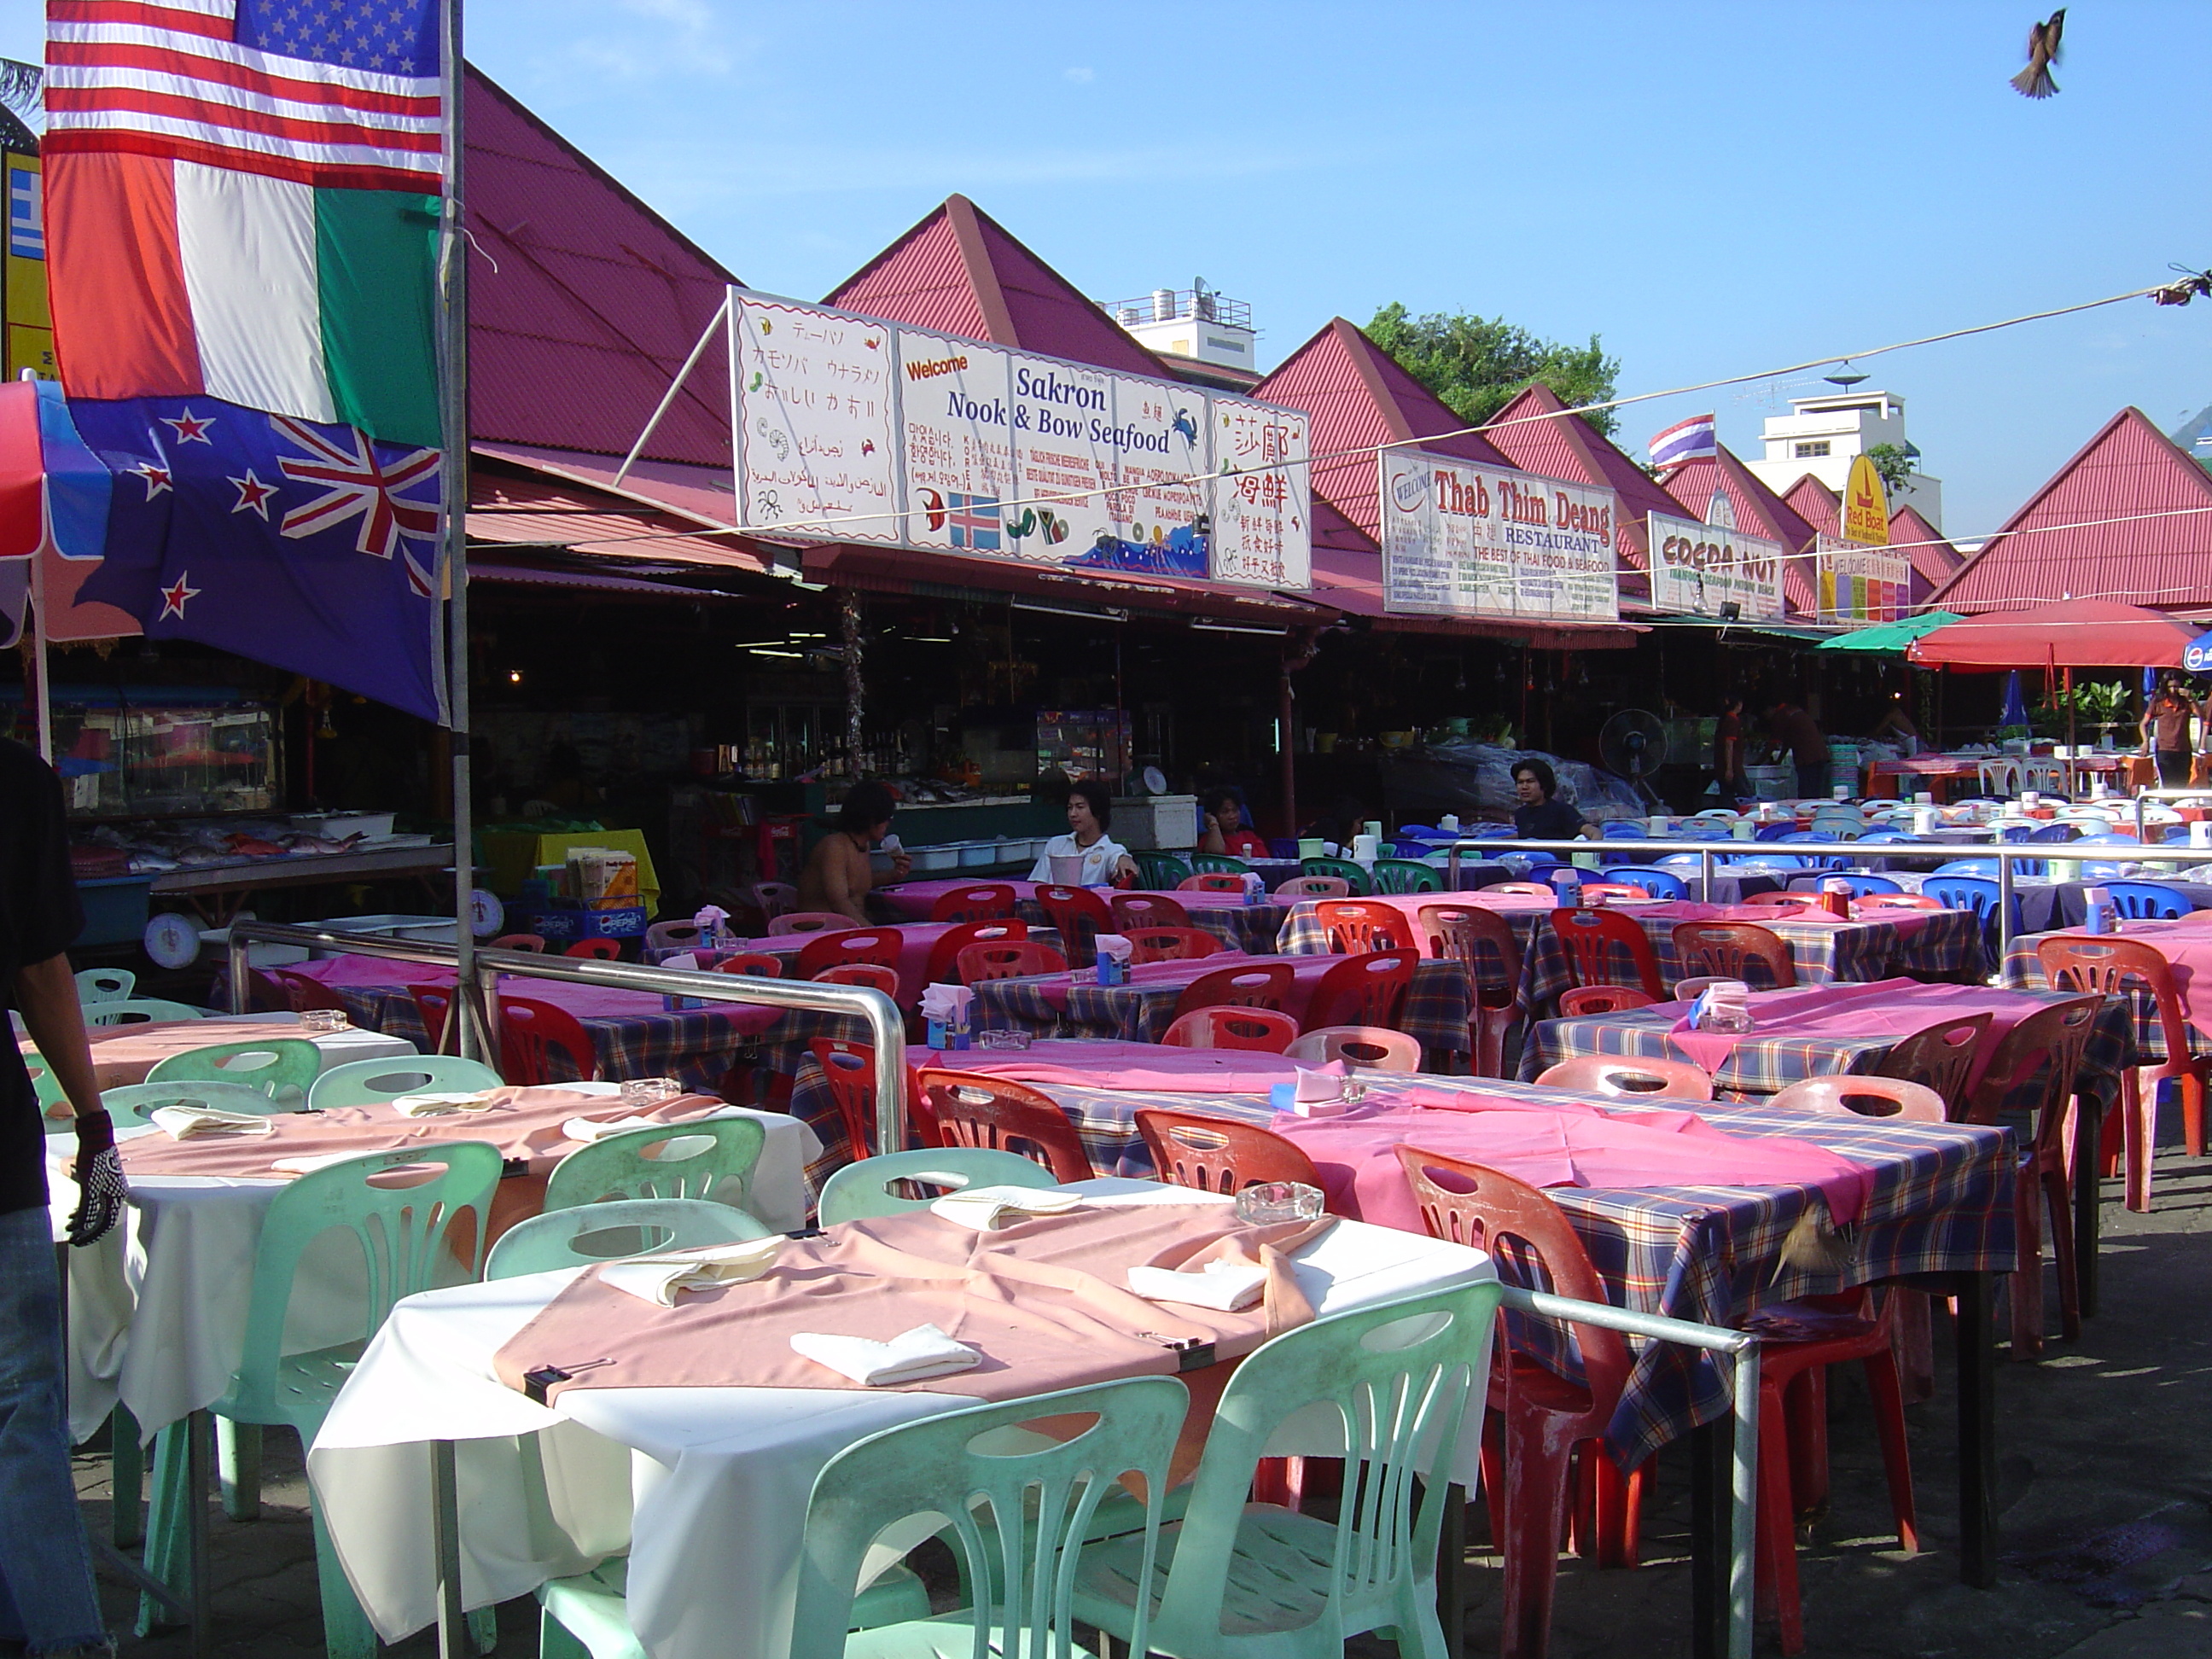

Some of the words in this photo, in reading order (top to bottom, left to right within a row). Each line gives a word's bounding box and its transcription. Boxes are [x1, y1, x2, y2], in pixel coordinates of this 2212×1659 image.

[906, 355, 969, 381] Welcome
[1016, 367, 1107, 411] Sakron
[947, 390, 1007, 426] Nook
[1014, 405, 1032, 430] &
[1038, 408, 1083, 440] Bow
[1090, 417, 1171, 454] Seafood
[1233, 463, 1289, 514] 海鮮
[1396, 470, 1431, 502] WELCOME
[1435, 470, 1490, 518] Thab
[1498, 480, 1548, 527] Thim
[1555, 491, 1610, 548] Deang
[1847, 505, 1863, 526] Red
[1866, 510, 1884, 531] Boat
[1505, 527, 1599, 554] RESTAURANT
[1474, 546, 1489, 560] THE
[1491, 548, 1508, 562] BEST
[1510, 550, 1520, 563] OF
[1523, 551, 1540, 566] THAI
[1543, 554, 1566, 568] FOOD
[1568, 558, 1574, 569] &
[1575, 558, 1610, 573] SEAFOOD
[1662, 535, 1776, 584] COCOA-NUT
[1835, 558, 1866, 576] WELCOME
